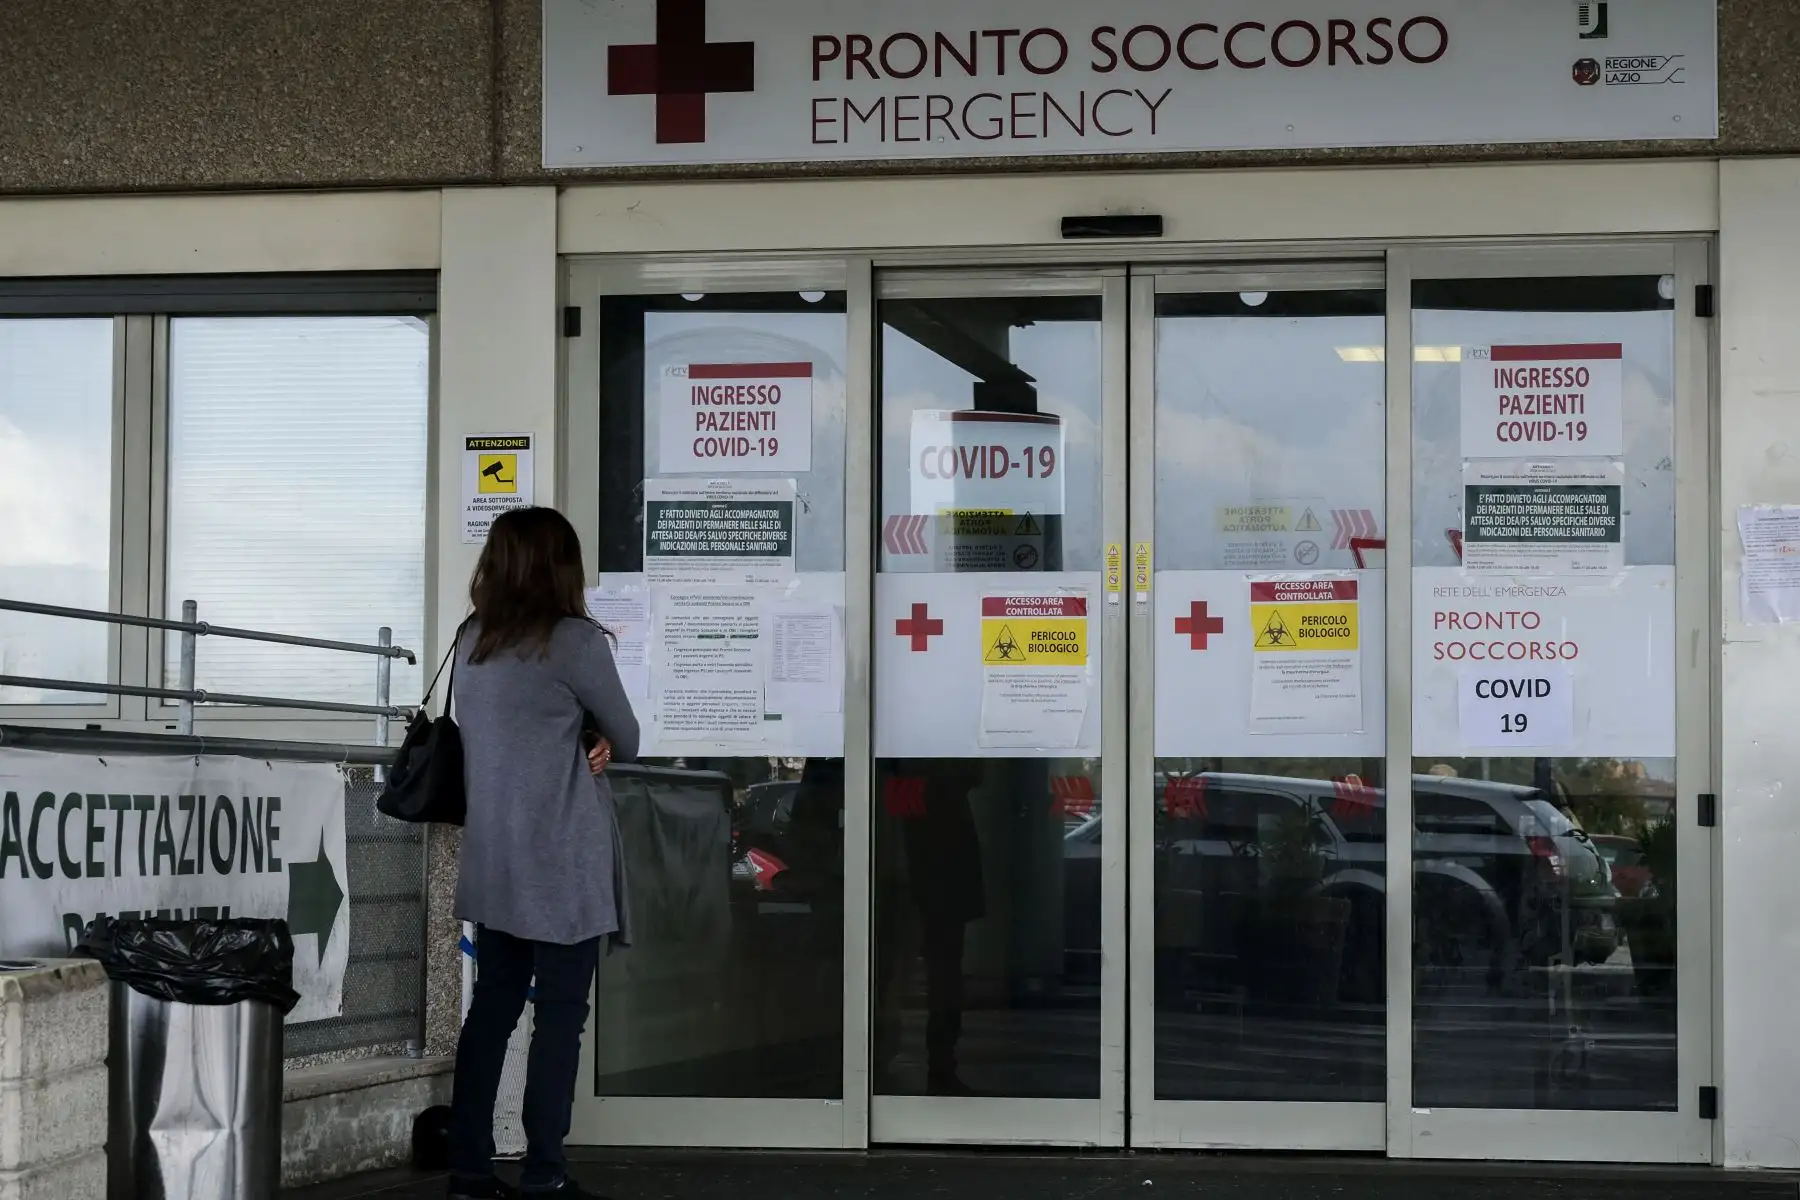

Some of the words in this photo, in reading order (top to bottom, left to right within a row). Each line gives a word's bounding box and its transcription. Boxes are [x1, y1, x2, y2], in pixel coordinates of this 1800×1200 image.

[811, 28, 1069, 82] PRONTO
[1090, 15, 1448, 72] SOCCORSO
[1605, 58, 1657, 69] REGIONE
[1605, 73, 1641, 83] LAZIO
[811, 88, 1172, 145] EMERGENCY
[1494, 366, 1590, 389] INGRESSO
[691, 384, 782, 406] INGRESSO
[1499, 393, 1584, 415] PAZIENTI
[696, 411, 776, 432] PAZIENTI
[1496, 421, 1588, 442] COVID-19
[469, 439, 527, 448] ATTENZIONE!
[693, 437, 779, 458] COVID-19
[919, 445, 1056, 479] COVID-19
[1479, 494, 1485, 504] E'
[1486, 494, 1505, 504] FATTO
[1506, 494, 1532, 504] DIVIETO
[1532, 494, 1547, 504] AGLI
[1548, 494, 1607, 504] ACCOMPAGNATORI
[660, 509, 665, 519] E'
[666, 509, 684, 519] FATTO
[684, 509, 709, 519] DIVIETO
[710, 509, 724, 519] AGLI
[724, 509, 780, 519] ACCOMPAGNATORI
[1476, 505, 1488, 515] DEI
[1488, 505, 1516, 515] PAZIENTI
[1518, 505, 1524, 515] DI
[1526, 505, 1564, 515] PERMANERE
[1564, 505, 1584, 515] NELLE
[1585, 505, 1601, 515] SALE
[1602, 505, 1609, 515] DI
[658, 520, 668, 530] DEI
[668, 520, 694, 530] PAZIENTI
[696, 520, 702, 530] DI
[704, 520, 739, 530] PERMANERE
[740, 520, 759, 530] NELLE
[760, 520, 774, 530] SALE
[774, 520, 782, 530] DI
[1470, 516, 1494, 526] ATTESA
[1495, 516, 1506, 526] DEI
[1506, 516, 1530, 526] DEA/PS
[1530, 516, 1552, 526] SALVO
[1552, 516, 1588, 526] SPECIFICHE
[1588, 516, 1616, 526] DIVERSE
[651, 531, 673, 540] ATTESA
[674, 531, 684, 540] DEI
[684, 531, 707, 540] DEA/PS
[708, 531, 728, 540] SALVO
[728, 531, 762, 540] SPECIFICHE
[762, 531, 788, 540] DIVERSE
[1480, 527, 1520, 537] INDICAZIONI
[1520, 527, 1532, 537] DEL
[1534, 527, 1571, 537] PERSONALE
[1572, 527, 1606, 537] SANITARIO
[660, 542, 698, 551] INDICAZIONI
[698, 542, 710, 551] DEL
[710, 542, 746, 551] PERSONALE
[746, 542, 778, 551] SANITARIO
[1274, 582, 1311, 590] ACCESSO
[1312, 581, 1334, 590] AREA
[1275, 592, 1333, 601] CONTROLLATA
[1433, 587, 1459, 598] RETE
[1005, 597, 1042, 606] ACCESSO
[1042, 597, 1064, 606] AREA
[1006, 607, 1063, 616] CONTROLLATA
[1301, 615, 1348, 626] PERICOLO
[1433, 611, 1541, 630] PRONTO
[1031, 631, 1076, 641] PERICOLO
[1298, 627, 1350, 638] BIOLOGICO
[1028, 643, 1079, 654] BIOLOGICO
[1433, 641, 1579, 660] SOCCORSO
[1475, 678, 1551, 699] COVID
[1500, 713, 1528, 733] 19
[0, 790, 283, 880] ACCETTAZIONE
